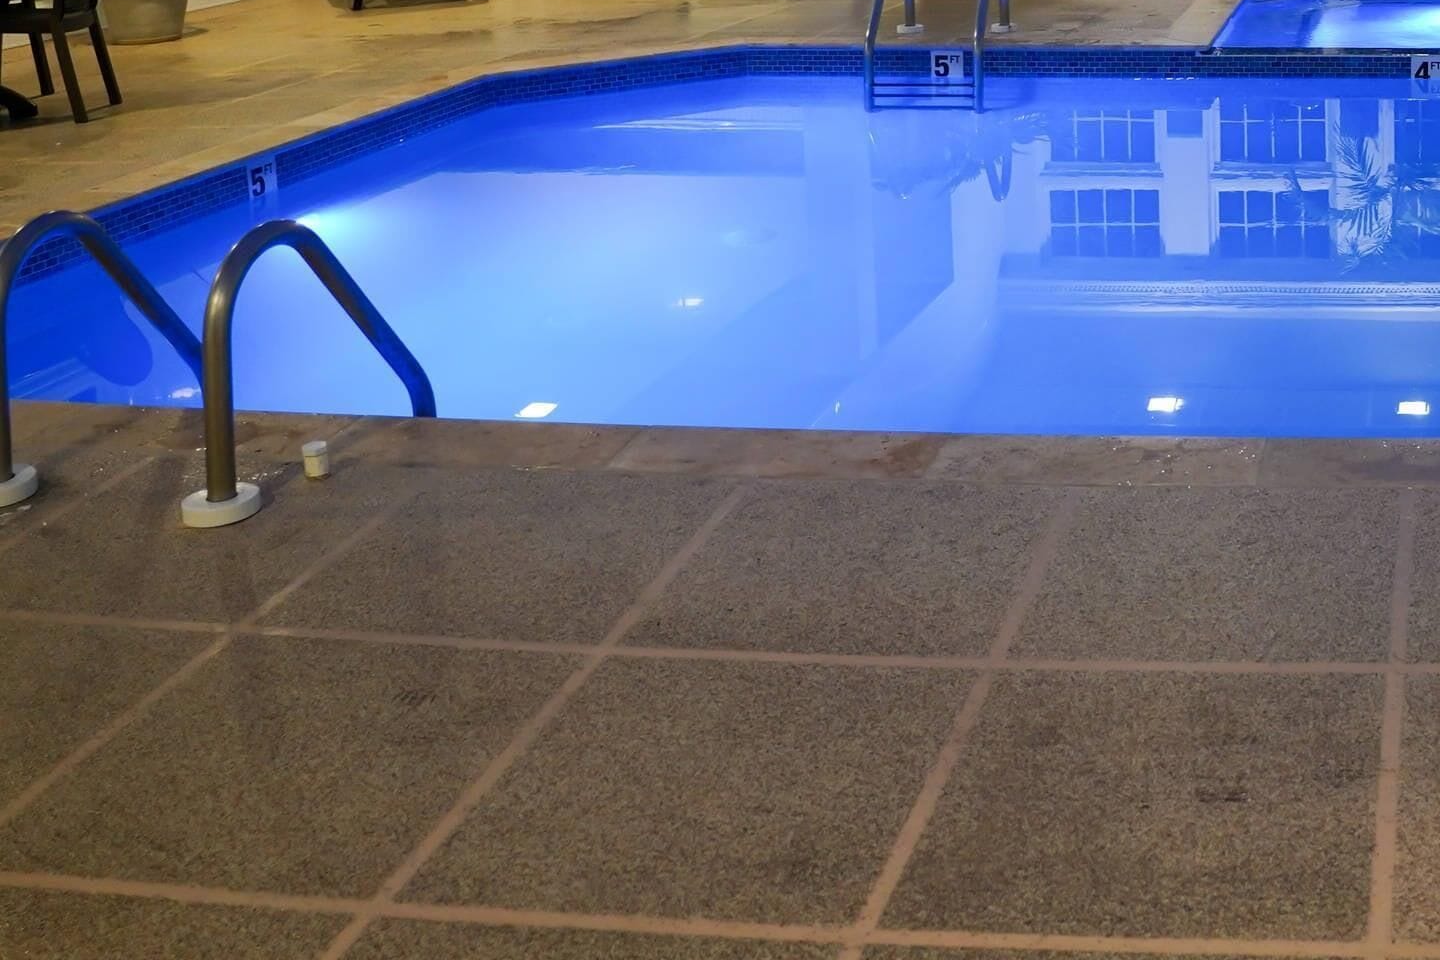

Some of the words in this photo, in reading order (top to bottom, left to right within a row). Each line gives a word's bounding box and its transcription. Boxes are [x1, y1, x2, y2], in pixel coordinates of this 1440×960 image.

[935, 54, 950, 77] 5
[950, 55, 961, 64] FT
[1414, 61, 1431, 79] 4
[1430, 61, 1440, 70] FT
[251, 166, 265, 197] 5
